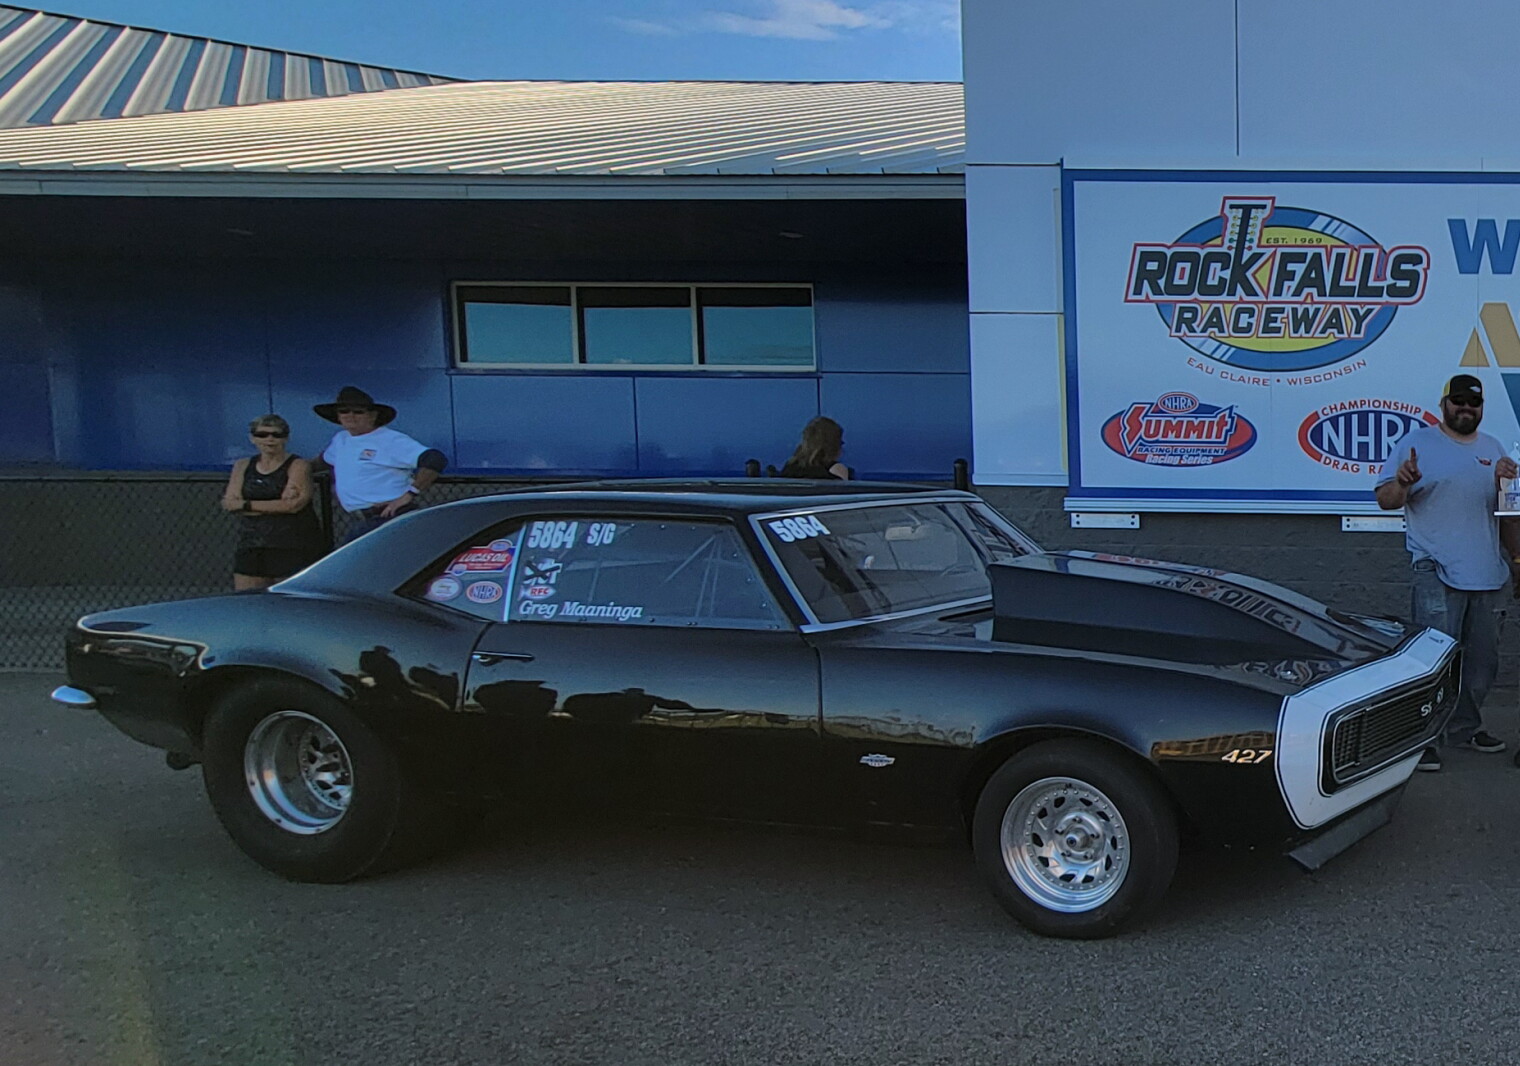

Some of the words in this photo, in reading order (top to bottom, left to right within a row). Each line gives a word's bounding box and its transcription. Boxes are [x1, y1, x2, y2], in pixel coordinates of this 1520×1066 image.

[1132, 203, 1267, 297] ROCK
[1272, 251, 1424, 298] FALLS
[1174, 305, 1376, 336] RACEWAY
[1186, 357, 1215, 375] EAU
[1219, 370, 1271, 387] CLAIRE
[1287, 359, 1367, 386] WISCONSIN
[1165, 396, 1193, 410] NHRA
[1321, 399, 1422, 417] CHAMPIONSHIP
[1322, 412, 1421, 461] NHR
[1146, 455, 1180, 465] Racing
[1181, 455, 1214, 465] Series
[1173, 447, 1226, 455] EQUIPMENT
[1323, 456, 1360, 473] DRAG
[527, 521, 579, 548] 5864
[586, 522, 617, 547] S/G
[768, 515, 832, 543] 5864
[472, 584, 498, 600] NHRA
[520, 600, 558, 619] Greg
[559, 602, 643, 621] Maaninga
[1221, 749, 1273, 764] 427
